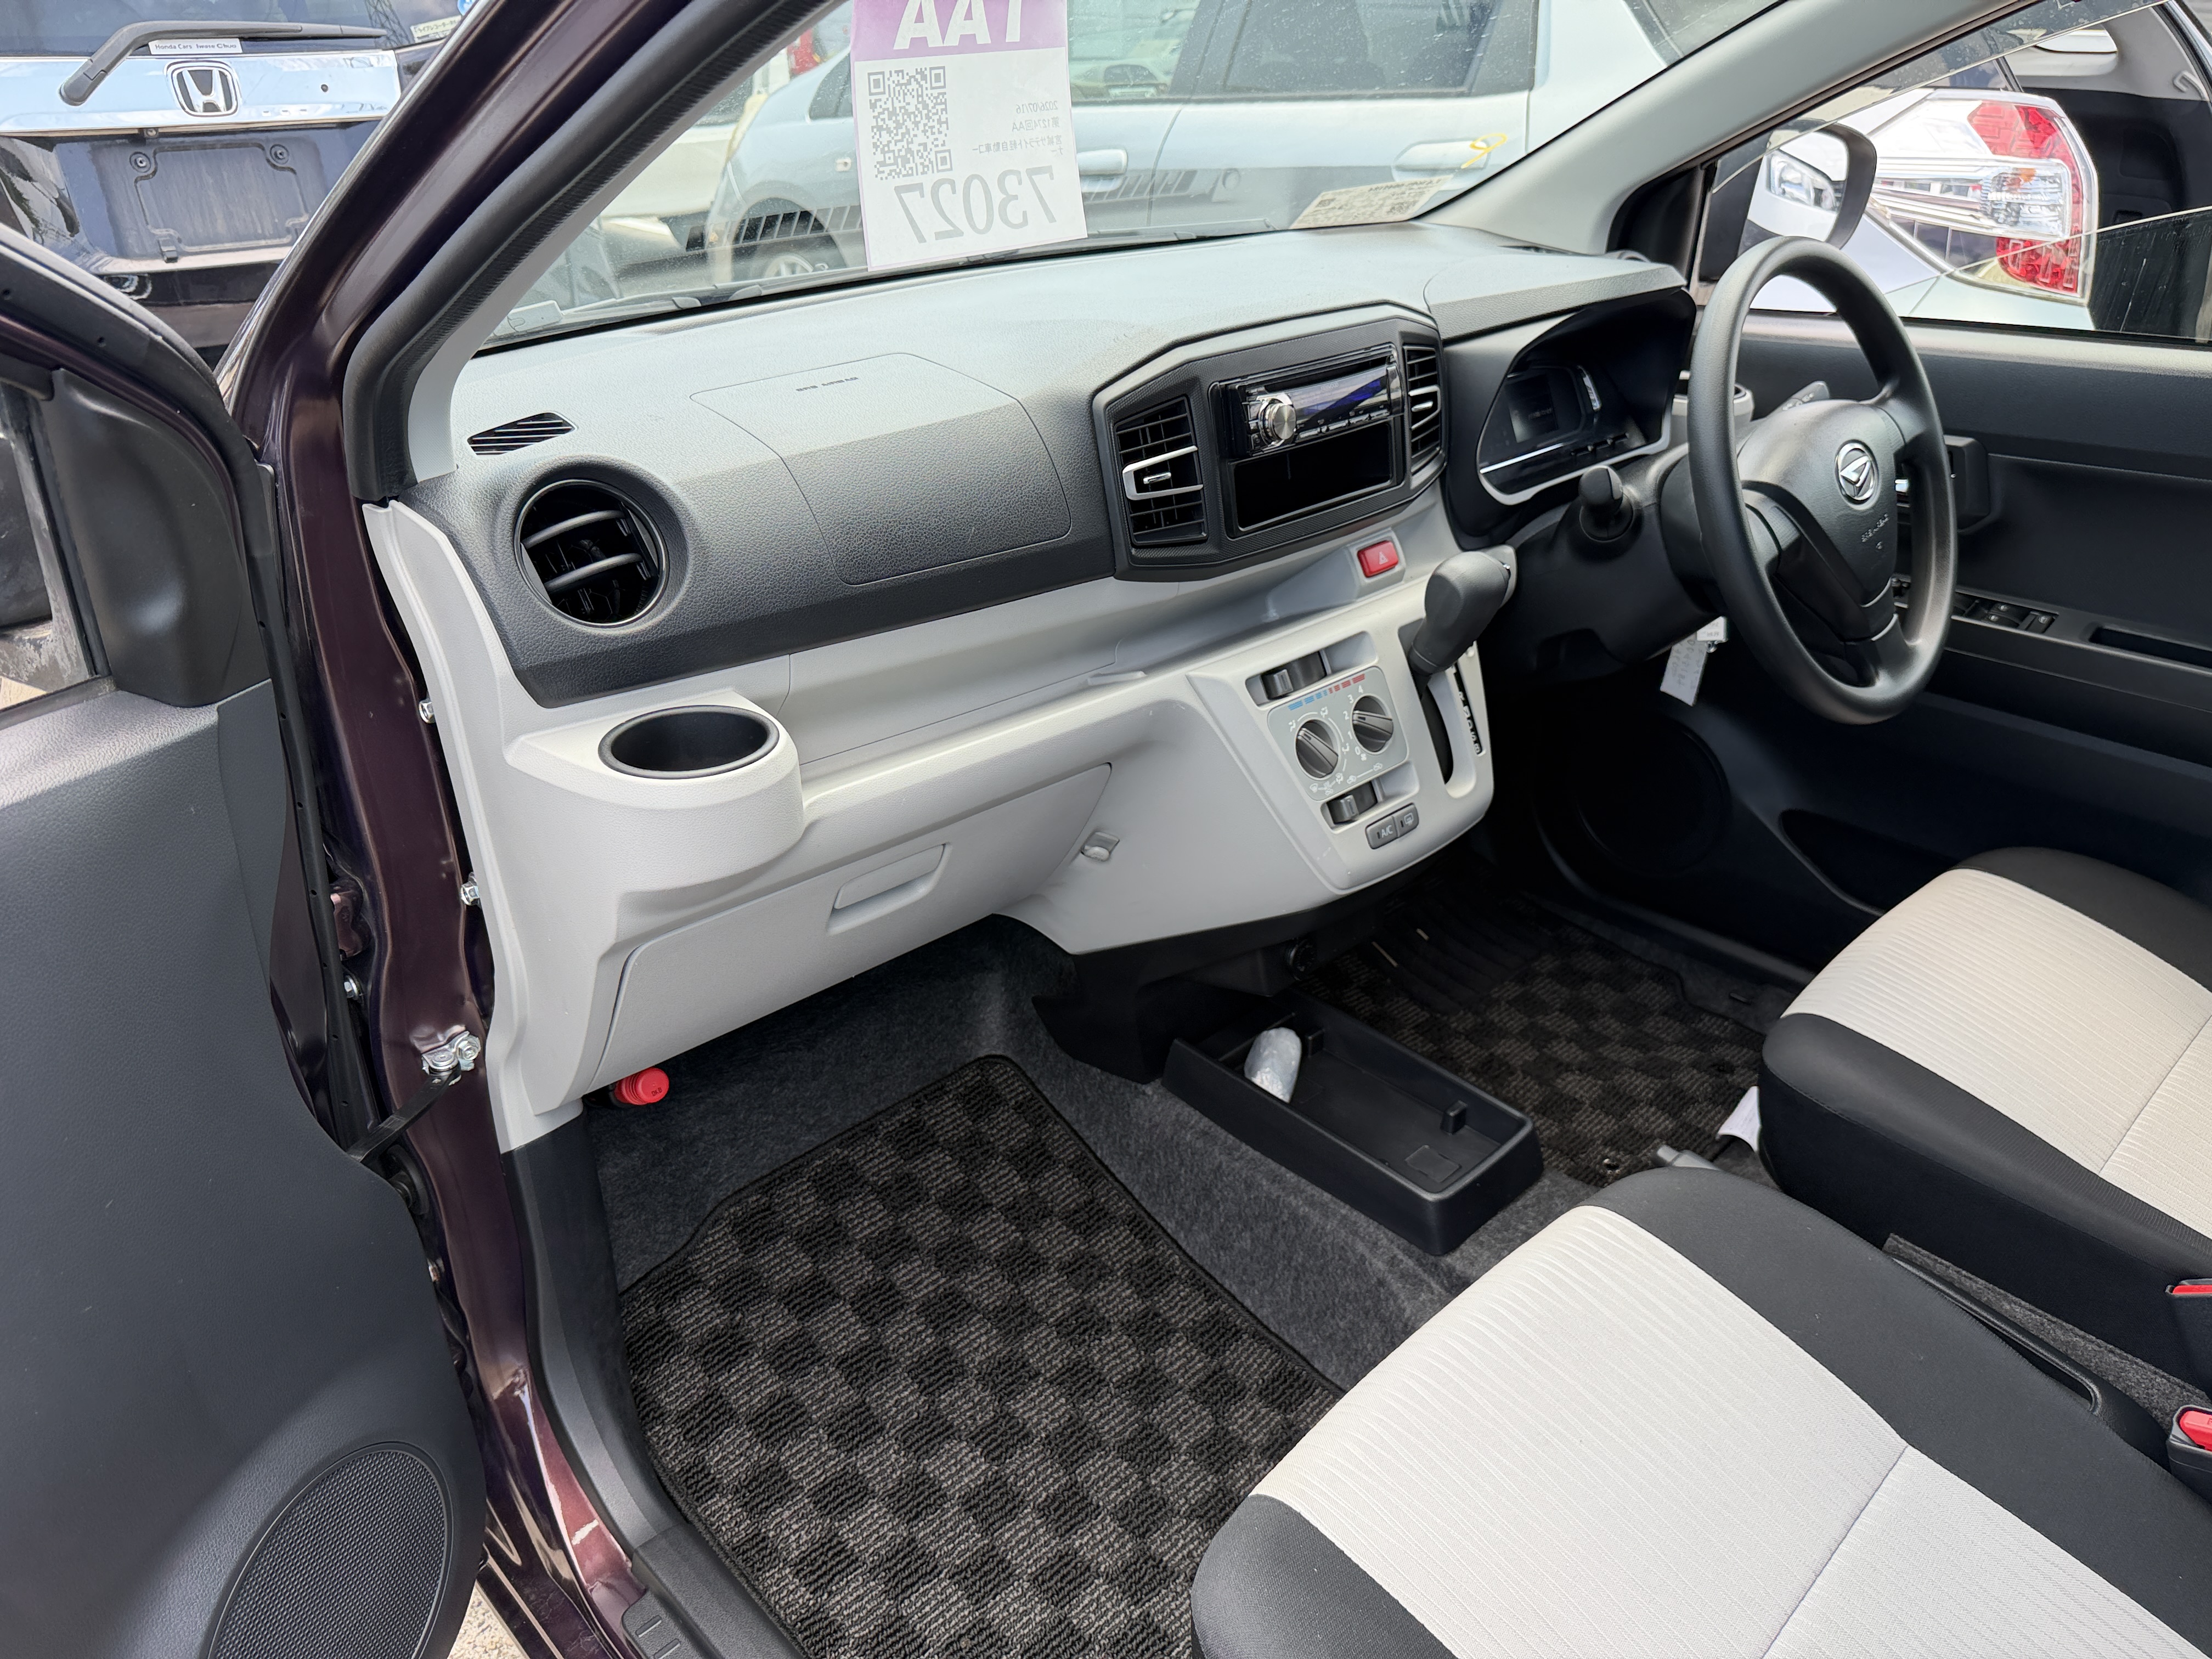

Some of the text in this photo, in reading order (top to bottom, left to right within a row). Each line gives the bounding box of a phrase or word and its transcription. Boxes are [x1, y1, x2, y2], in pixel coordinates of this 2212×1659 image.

[1358, 685, 1364, 693] 4
[1347, 695, 1354, 704] 3
[1342, 710, 1350, 720] 2
[1347, 730, 1353, 740] 1
[1381, 825, 1393, 838] A/C
